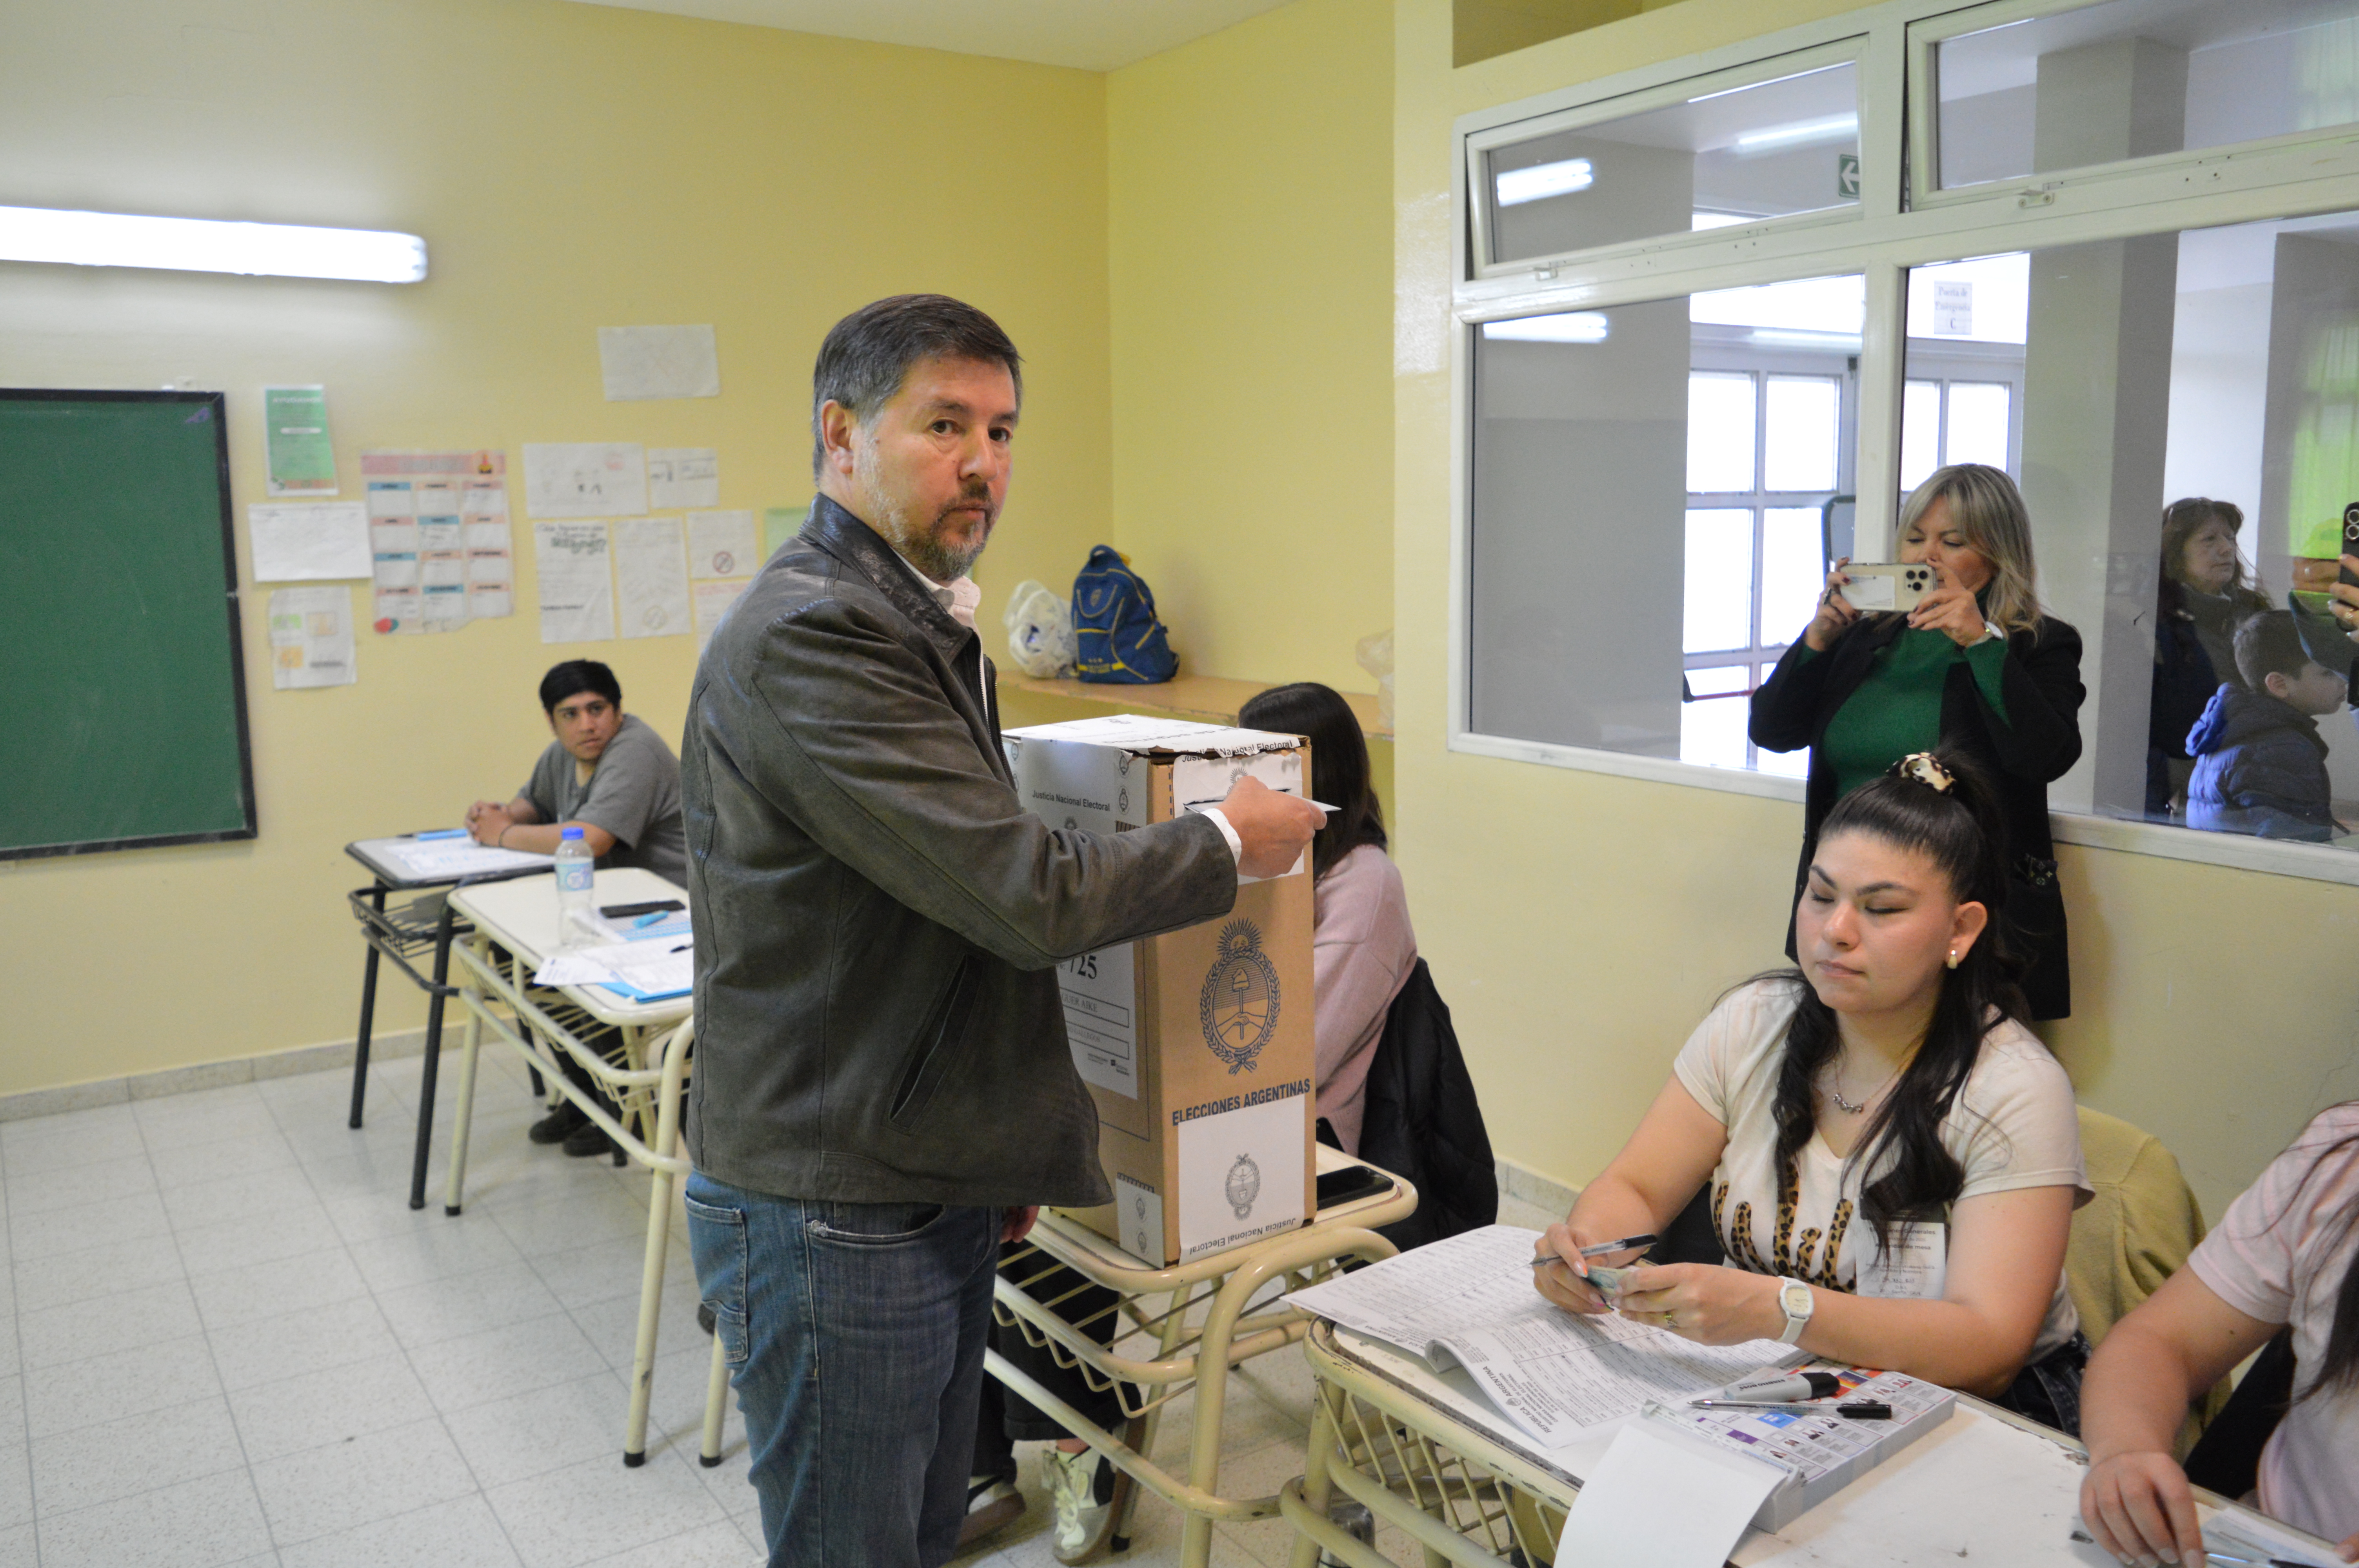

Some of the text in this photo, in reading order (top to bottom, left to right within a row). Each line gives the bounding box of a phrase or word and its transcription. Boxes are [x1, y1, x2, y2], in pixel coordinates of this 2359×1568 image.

[1032, 790, 1110, 811] Justicia Nacional Electoral
[1081, 1000, 1098, 1013] AIKE
[1172, 1078, 1310, 1126] ELECCIONES ARGENTINAS
[1190, 1218, 1296, 1254] Justicia Nacional Electoral
[1481, 1366, 1552, 1433] REPÚBLICA ARGENTINA
